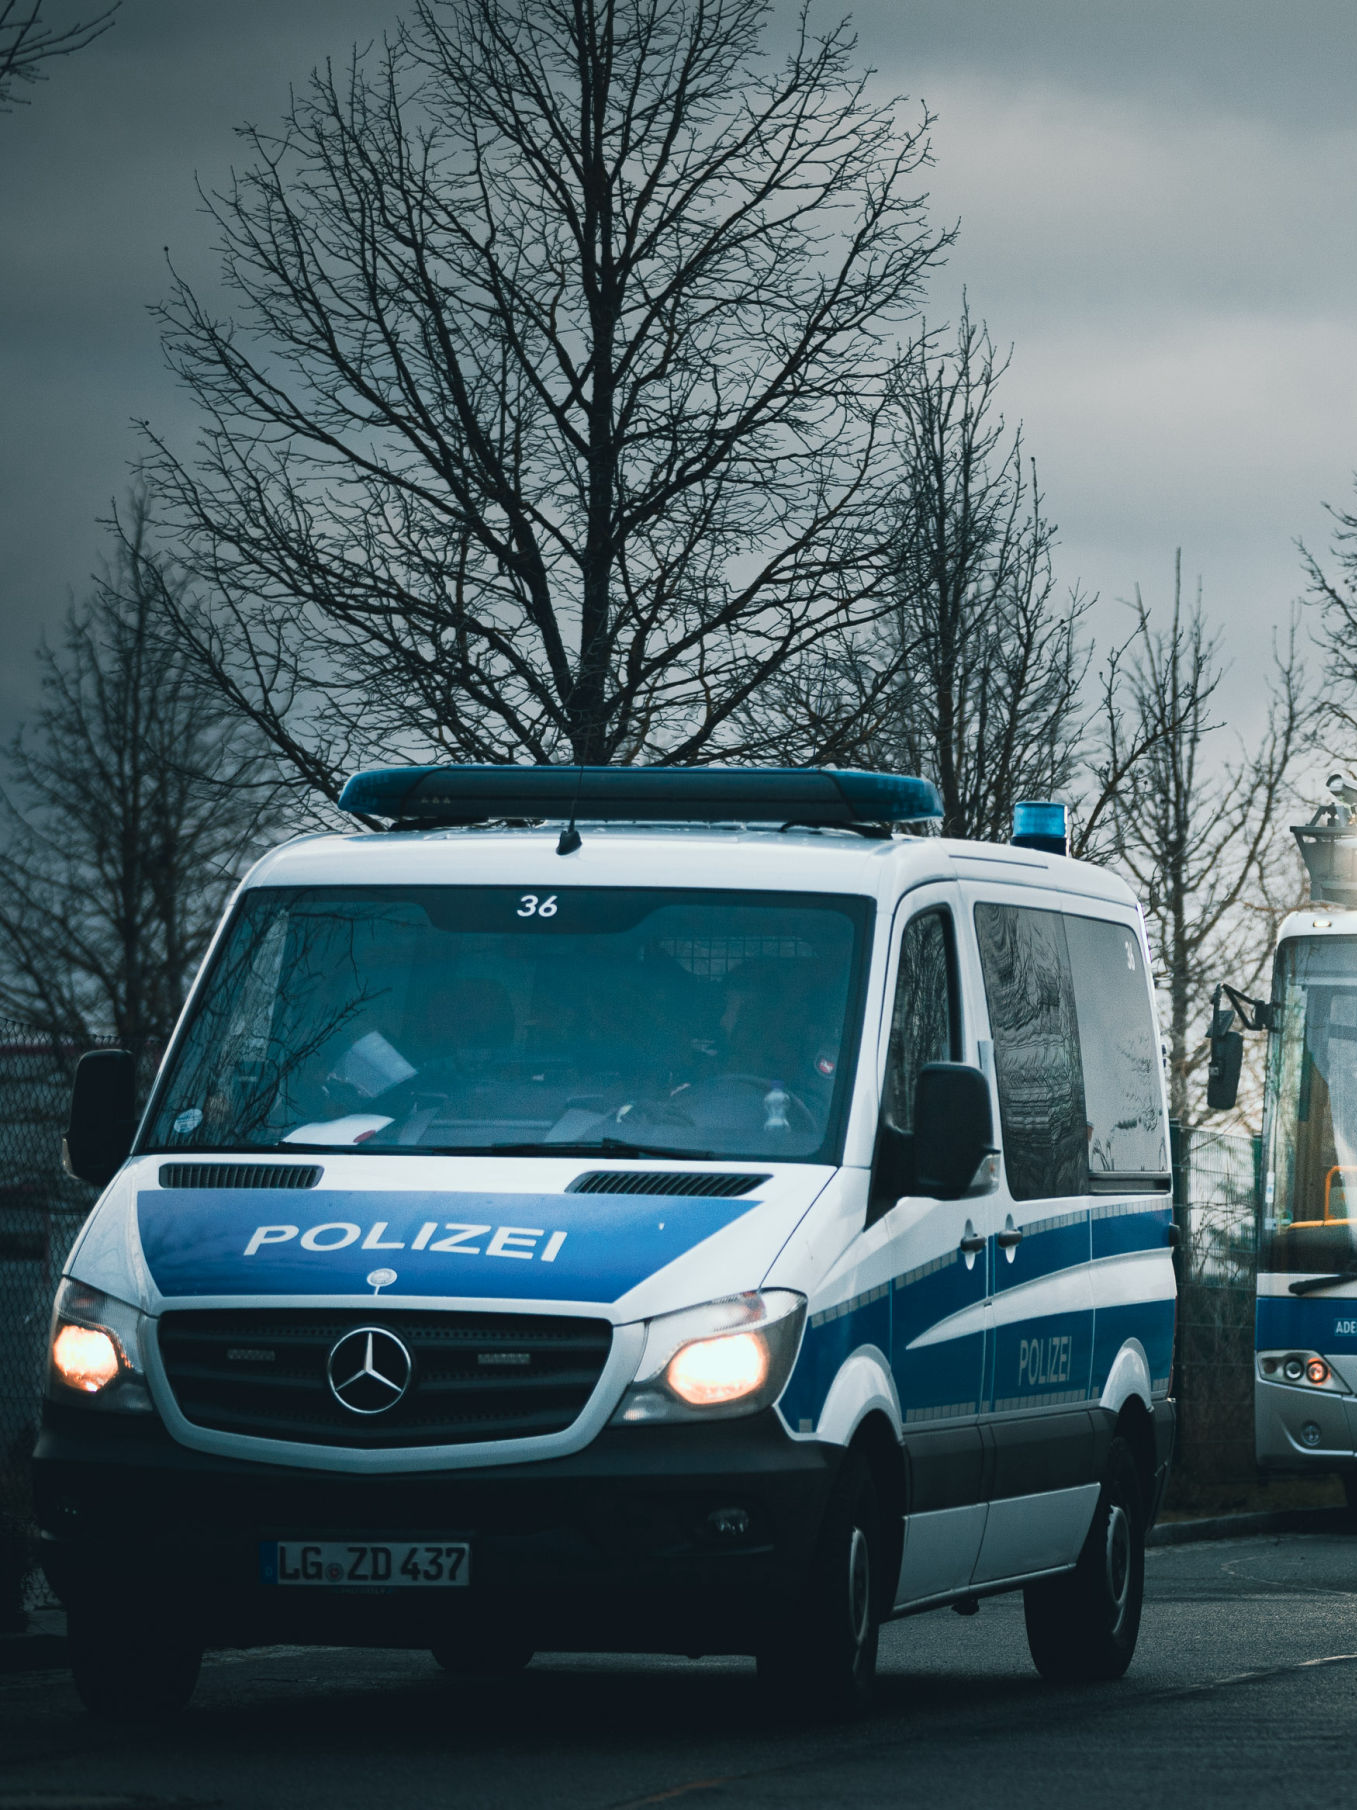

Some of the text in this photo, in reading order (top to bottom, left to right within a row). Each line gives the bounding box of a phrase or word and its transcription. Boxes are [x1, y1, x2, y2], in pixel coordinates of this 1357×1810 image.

[517, 894, 558, 917] 36
[244, 1222, 568, 1262] POLIZEI
[1018, 1336, 1072, 1386] POLIZEI
[279, 1546, 466, 1581] LG ZD 437
